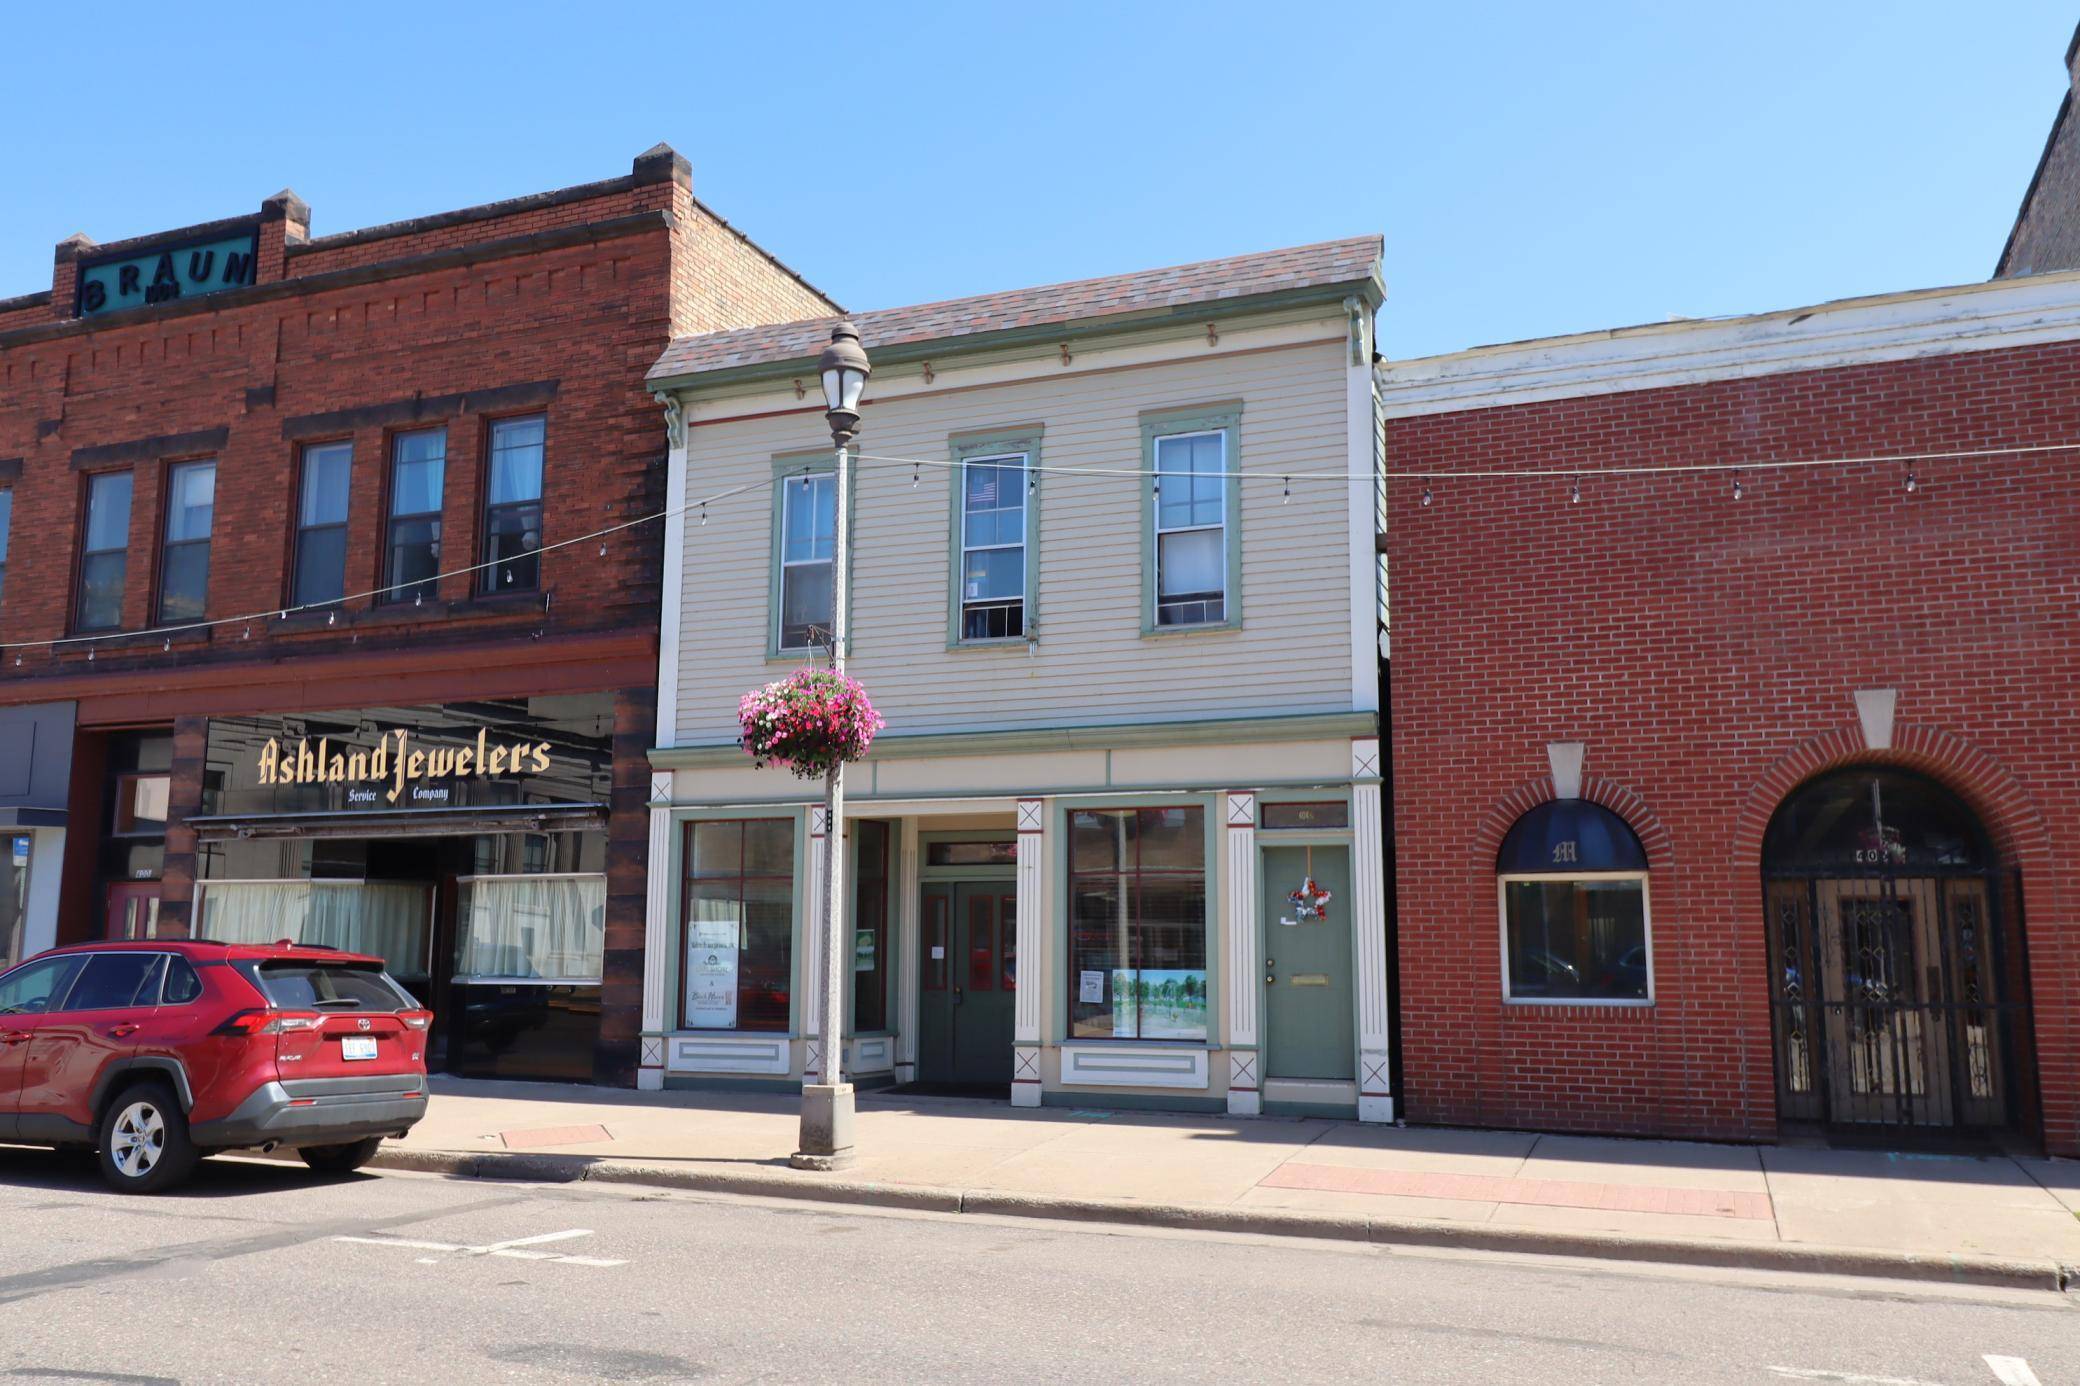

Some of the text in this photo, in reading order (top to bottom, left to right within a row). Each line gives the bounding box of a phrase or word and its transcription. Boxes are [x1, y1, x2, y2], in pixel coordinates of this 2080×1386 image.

[83, 252, 250, 312] BRAUN
[257, 726, 552, 803] Ashland Jewelers
[348, 786, 449, 802] Service Company
